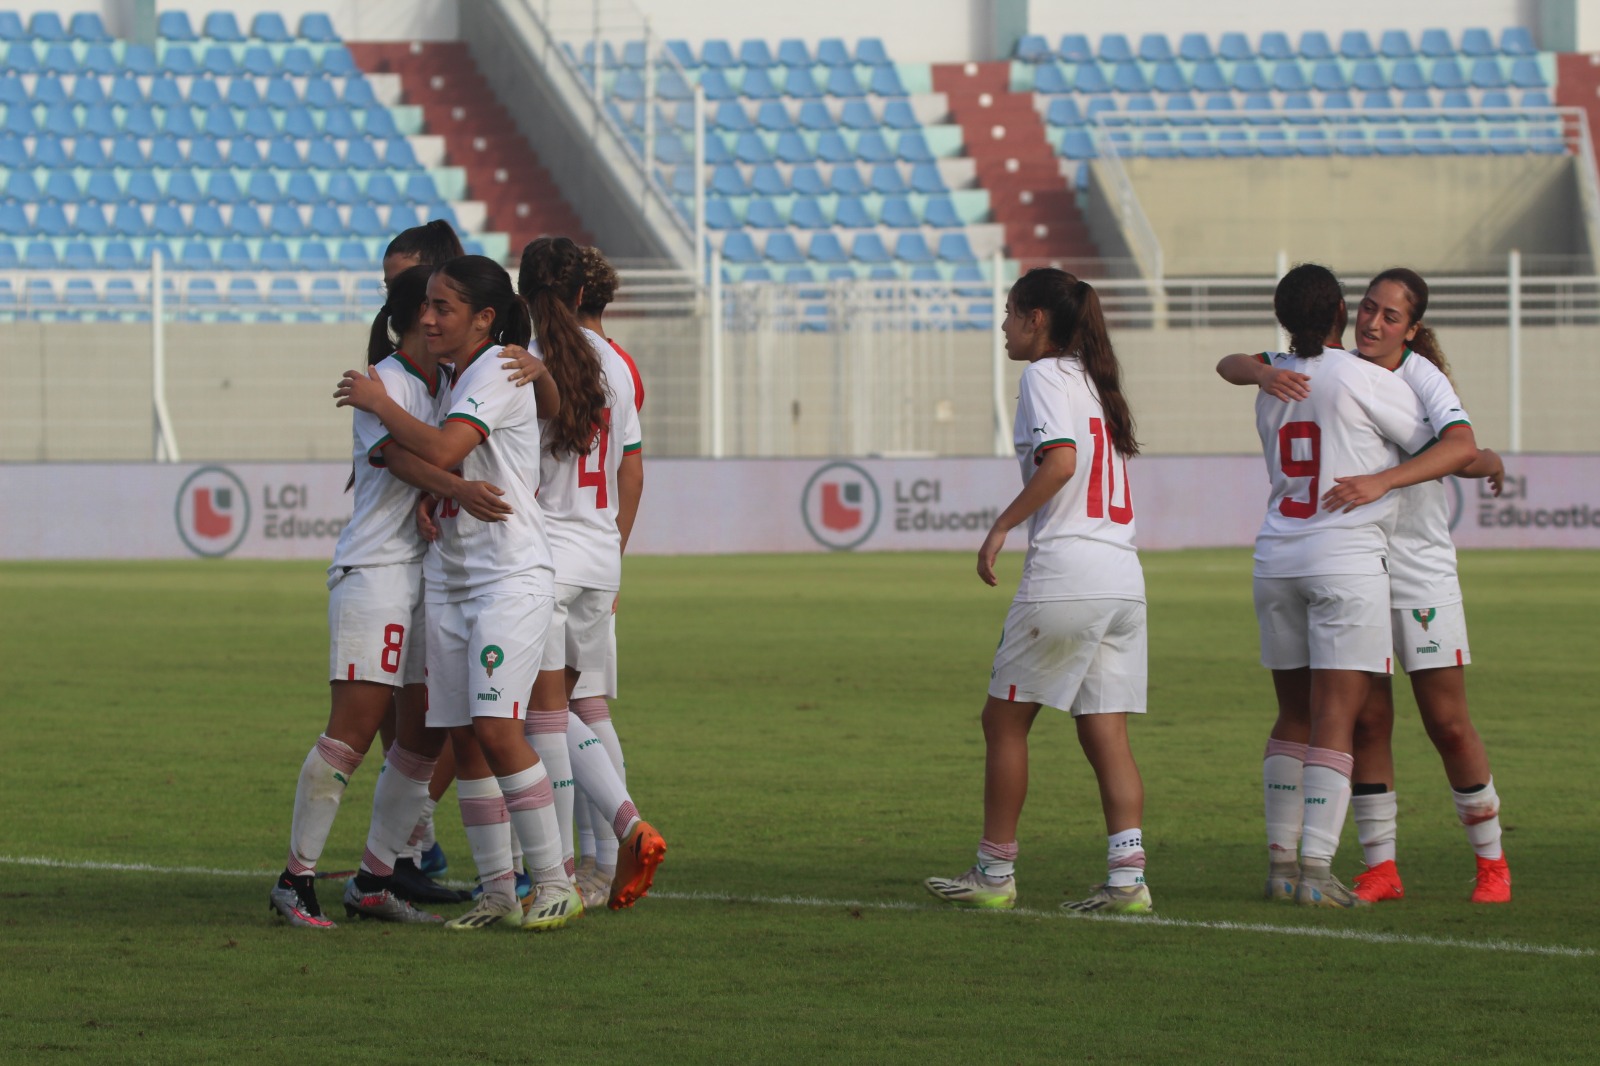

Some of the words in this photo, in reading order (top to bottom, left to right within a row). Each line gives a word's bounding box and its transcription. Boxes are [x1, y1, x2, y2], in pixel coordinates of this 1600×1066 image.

[577, 407, 611, 510] 4
[1086, 417, 1134, 525] 10
[1278, 421, 1322, 520] 9
[264, 482, 307, 509] LCI
[893, 478, 942, 504] LCI
[894, 506, 999, 533] Educati
[380, 622, 405, 674] 8
[1416, 645, 1438, 655] PUMA
[477, 692, 498, 702] PUMA
[577, 738, 602, 751] FRM
[552, 777, 576, 790] FRM
